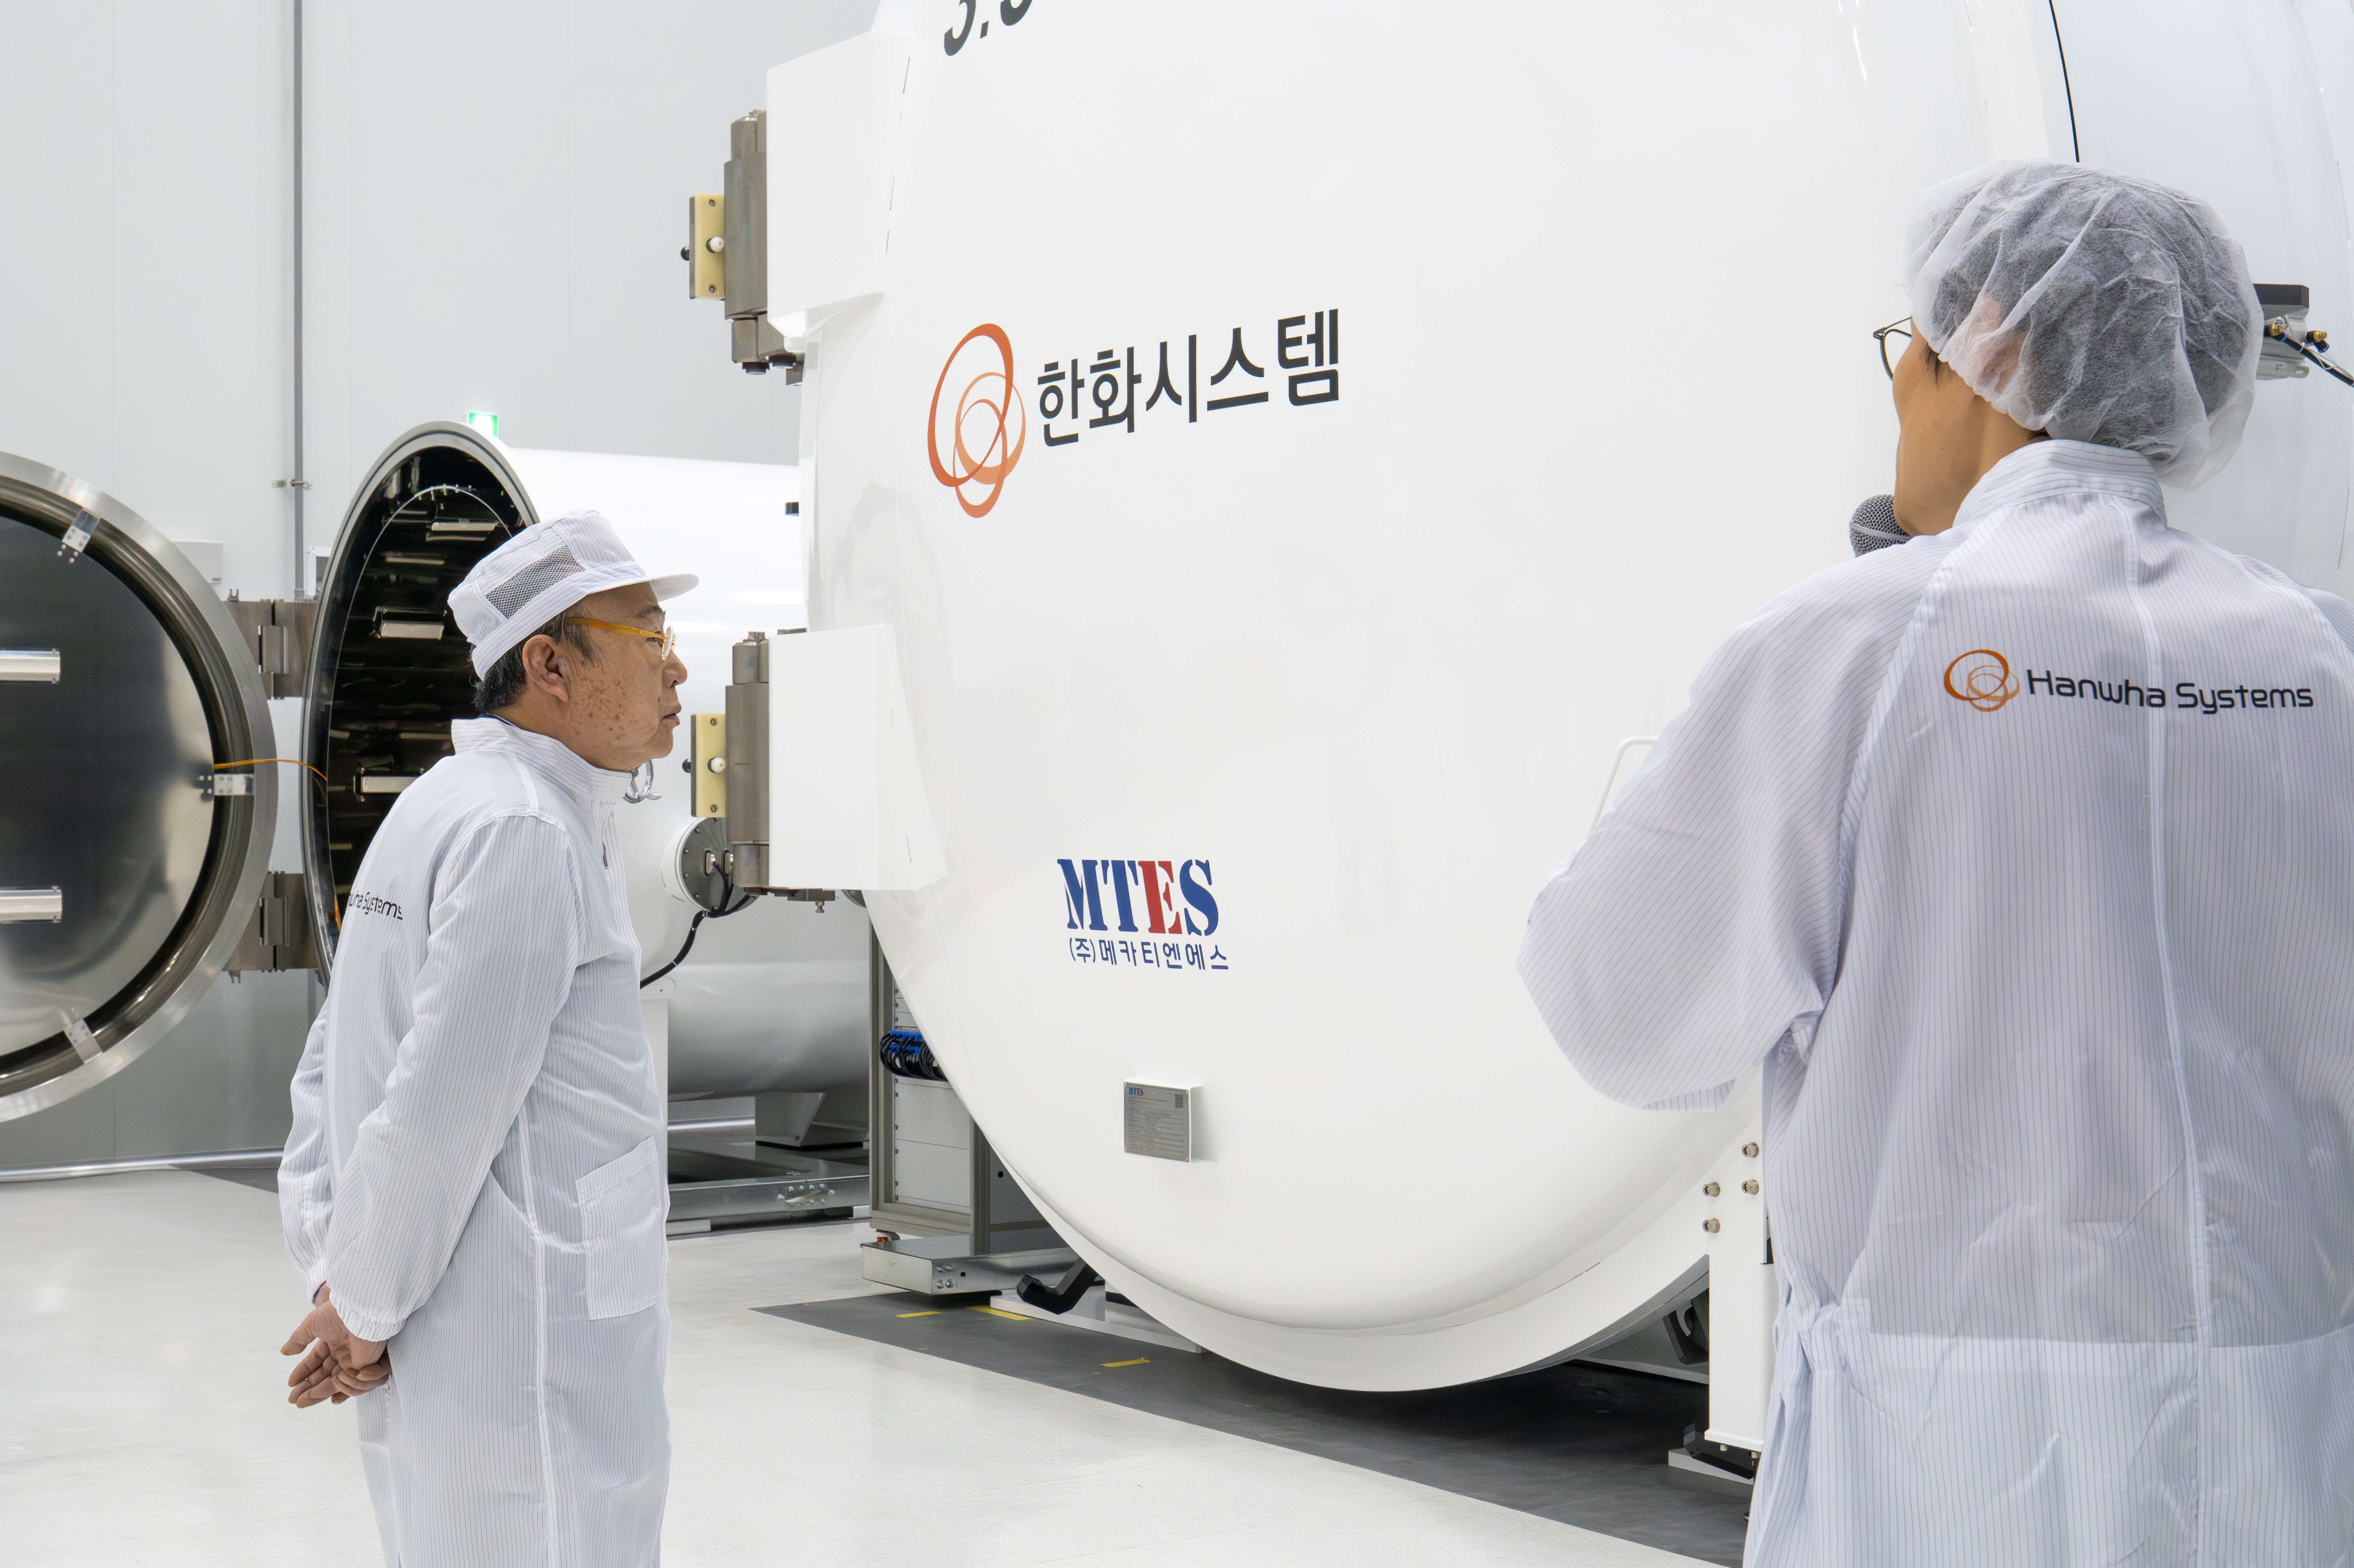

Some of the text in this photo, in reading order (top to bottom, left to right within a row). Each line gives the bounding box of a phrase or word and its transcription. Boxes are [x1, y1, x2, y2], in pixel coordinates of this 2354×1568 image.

[1037, 308, 1339, 447] 한화시스템
[2026, 669, 2314, 715] Hanwha Systems
[362, 892, 403, 921] Systems
[1056, 858, 1219, 936] MTES
[1069, 937, 1229, 971] (주)메카티엔에스
